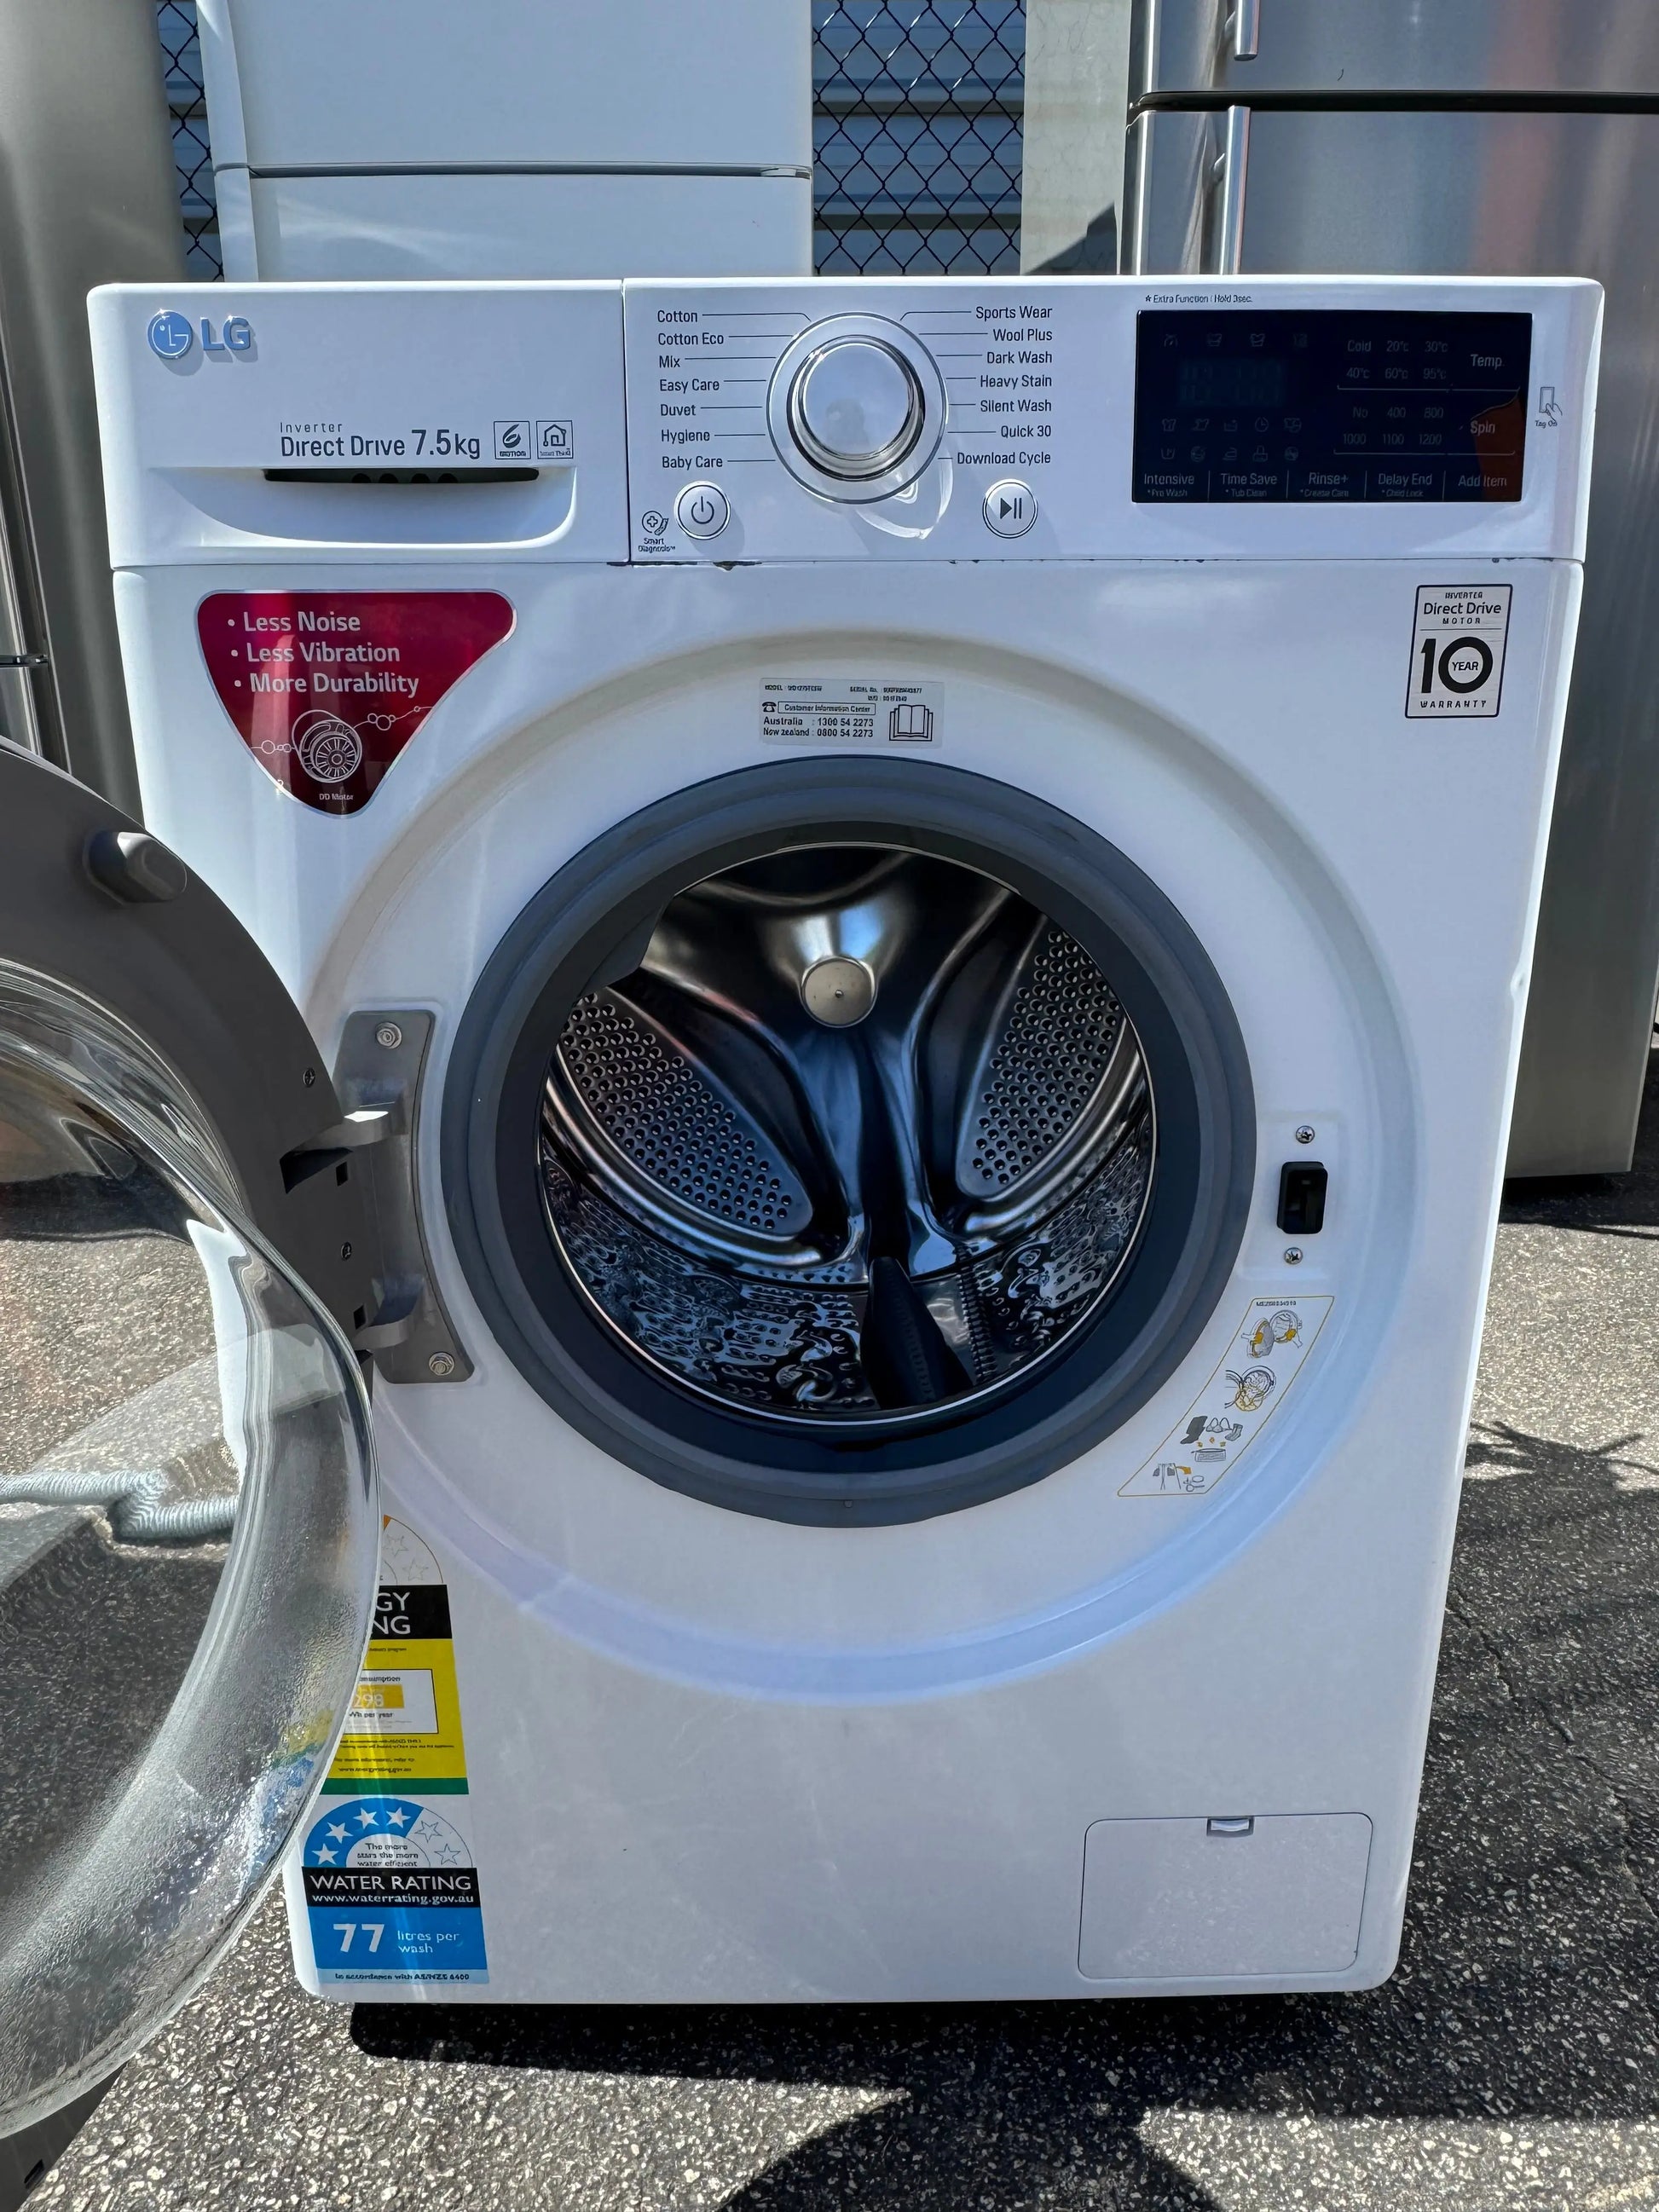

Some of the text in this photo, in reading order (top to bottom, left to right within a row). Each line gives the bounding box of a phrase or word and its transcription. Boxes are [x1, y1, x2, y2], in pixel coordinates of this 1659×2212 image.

[657, 310, 698, 323] Cotton
[975, 306, 1053, 322] Sports Wear
[200, 315, 251, 350] LG
[658, 332, 725, 345] Cotton Eco
[992, 328, 1053, 342] Wool Plus
[1347, 340, 1372, 352] Cold
[659, 355, 680, 368] Mix
[986, 351, 1052, 364] Dark Wash
[660, 378, 720, 394] Easy Care
[980, 375, 1052, 390] Heavy Stain
[661, 404, 697, 416] Duvet
[980, 399, 1051, 413] Silent Wash
[1353, 407, 1444, 419] No 400 800
[280, 422, 343, 433] Inverter
[1001, 425, 1051, 438] Quick 30
[1470, 420, 1496, 436] Spin
[662, 429, 710, 444] Hygiene
[1343, 434, 1442, 445] 1000 1100 1200
[280, 430, 480, 459] Direct Drive 7.5kg
[662, 455, 723, 471] Baby Care
[957, 451, 1051, 466] Download Cycle
[1144, 473, 1194, 485] Intensive
[1220, 473, 1278, 485] Time Save
[1309, 472, 1349, 485] Rinse+
[1378, 473, 1432, 487] Delay End
[1458, 475, 1507, 487] Add Item
[1424, 602, 1501, 615] Direct Drive
[243, 611, 361, 632] Less Noise
[246, 642, 400, 662] Less Vibration
[1420, 637, 1493, 694] 10
[1452, 661, 1479, 671] YEAR
[249, 673, 419, 698] More Durability
[784, 704, 813, 713] Customer
[815, 705, 850, 713] Information
[1420, 700, 1487, 708] WARRANTY
[763, 716, 803, 725] Australia
[818, 717, 838, 726] 1300
[841, 718, 851, 726] 54
[853, 718, 874, 727] 2273
[763, 727, 780, 736] New
[817, 728, 838, 737] 0800
[840, 728, 851, 737] 54
[853, 729, 874, 737] 2273
[309, 1875, 471, 1891] WATER RATING
[312, 1893, 474, 1905] www.waterrating.gov.au
[332, 1923, 384, 1953] 77
[397, 1931, 460, 1943] litres per
[398, 1943, 433, 1954] wash
